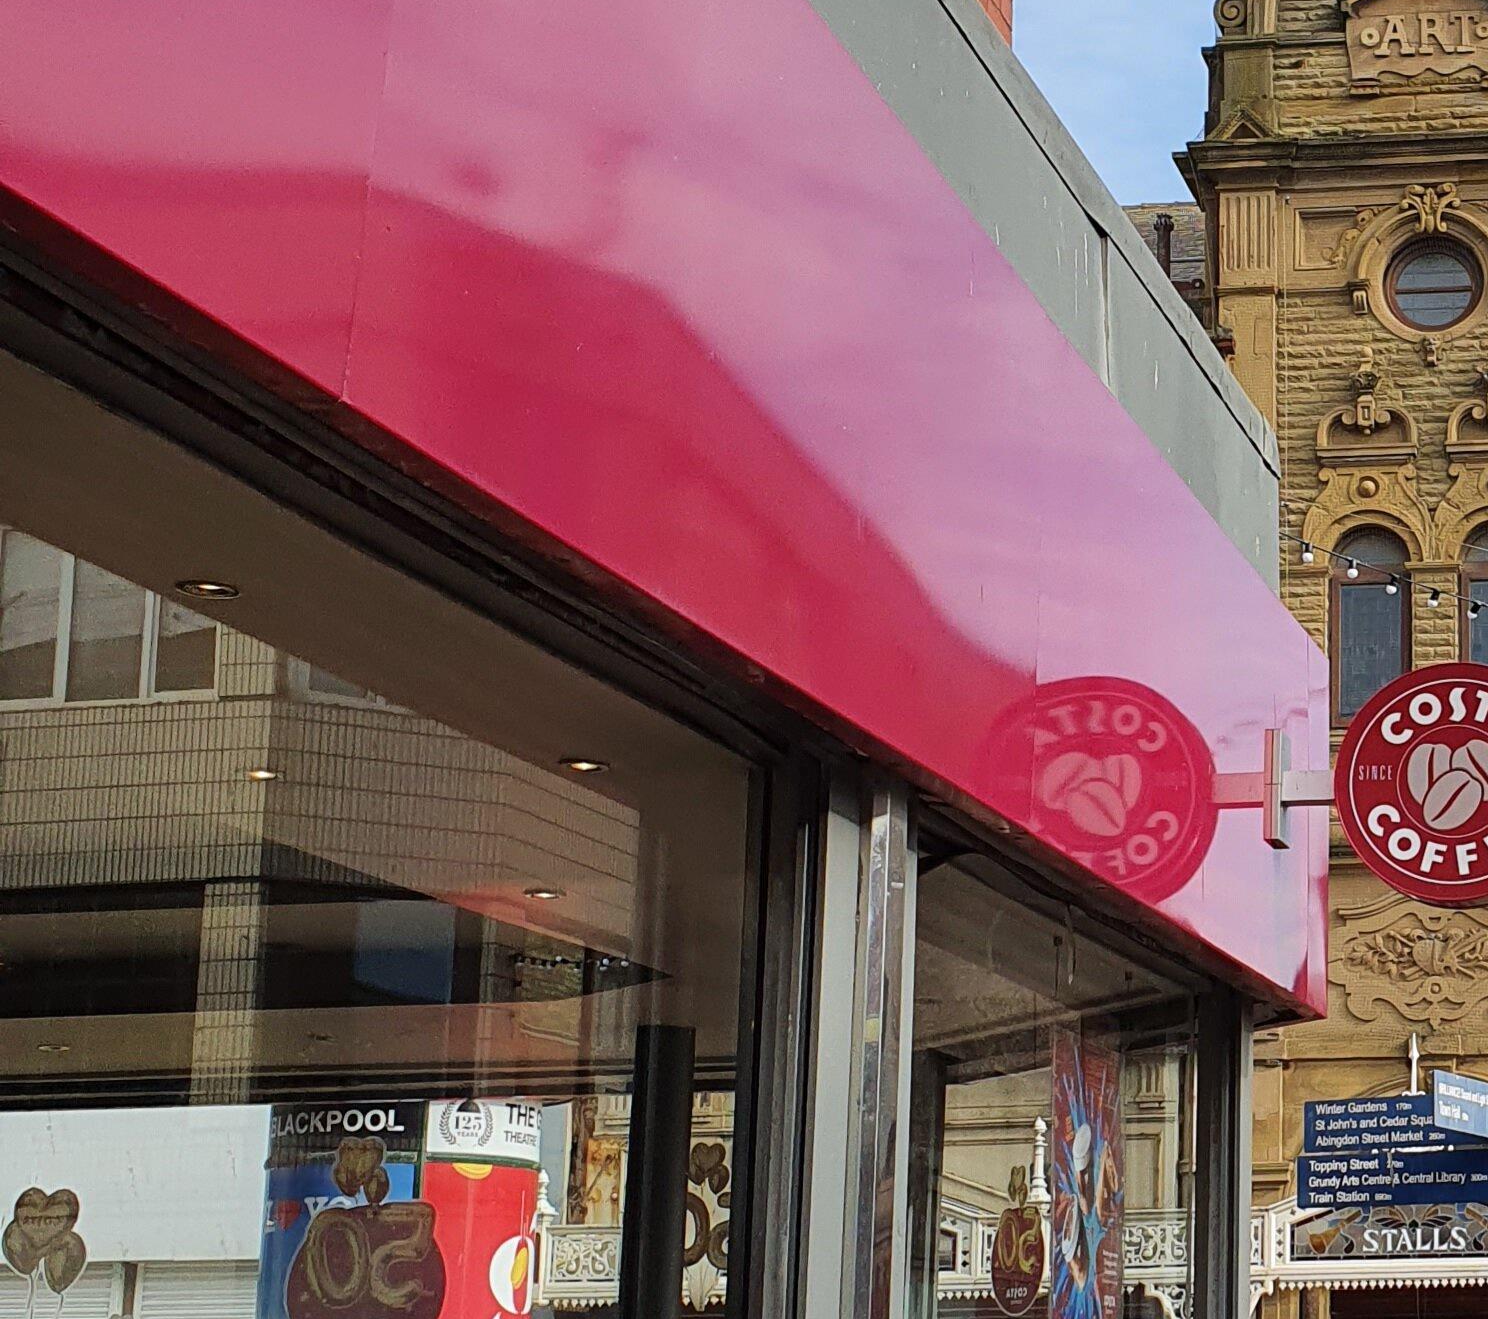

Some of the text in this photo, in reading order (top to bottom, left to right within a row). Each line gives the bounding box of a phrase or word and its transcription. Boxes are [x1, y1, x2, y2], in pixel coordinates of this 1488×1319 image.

[1374, 11, 1480, 56] ART
[1358, 764, 1393, 781] SINCE
[506, 1104, 535, 1124] THE
[1315, 1103, 1346, 1115] Winter
[1347, 1101, 1388, 1113] Gardens
[455, 1115, 482, 1131] 125
[1315, 1120, 1326, 1131] St
[1327, 1118, 1358, 1131] John's
[1359, 1117, 1378, 1129] and
[1379, 1115, 1408, 1127] Cedar
[1315, 1134, 1360, 1148] Abingdon
[1361, 1132, 1390, 1144] Street
[1390, 1130, 1424, 1142] Market
[1309, 1159, 1347, 1174] Topping
[1348, 1158, 1379, 1170] Street
[1309, 1176, 1341, 1189] Grundy
[1341, 1174, 1360, 1186] Arts
[1361, 1173, 1392, 1186] Centre
[1393, 1173, 1401, 1185] &
[1402, 1171, 1434, 1184] Central
[1436, 1169, 1467, 1185] Library
[1309, 1191, 1335, 1203] Train
[1336, 1189, 1370, 1203] Station
[1362, 1226, 1468, 1252] STALLS
